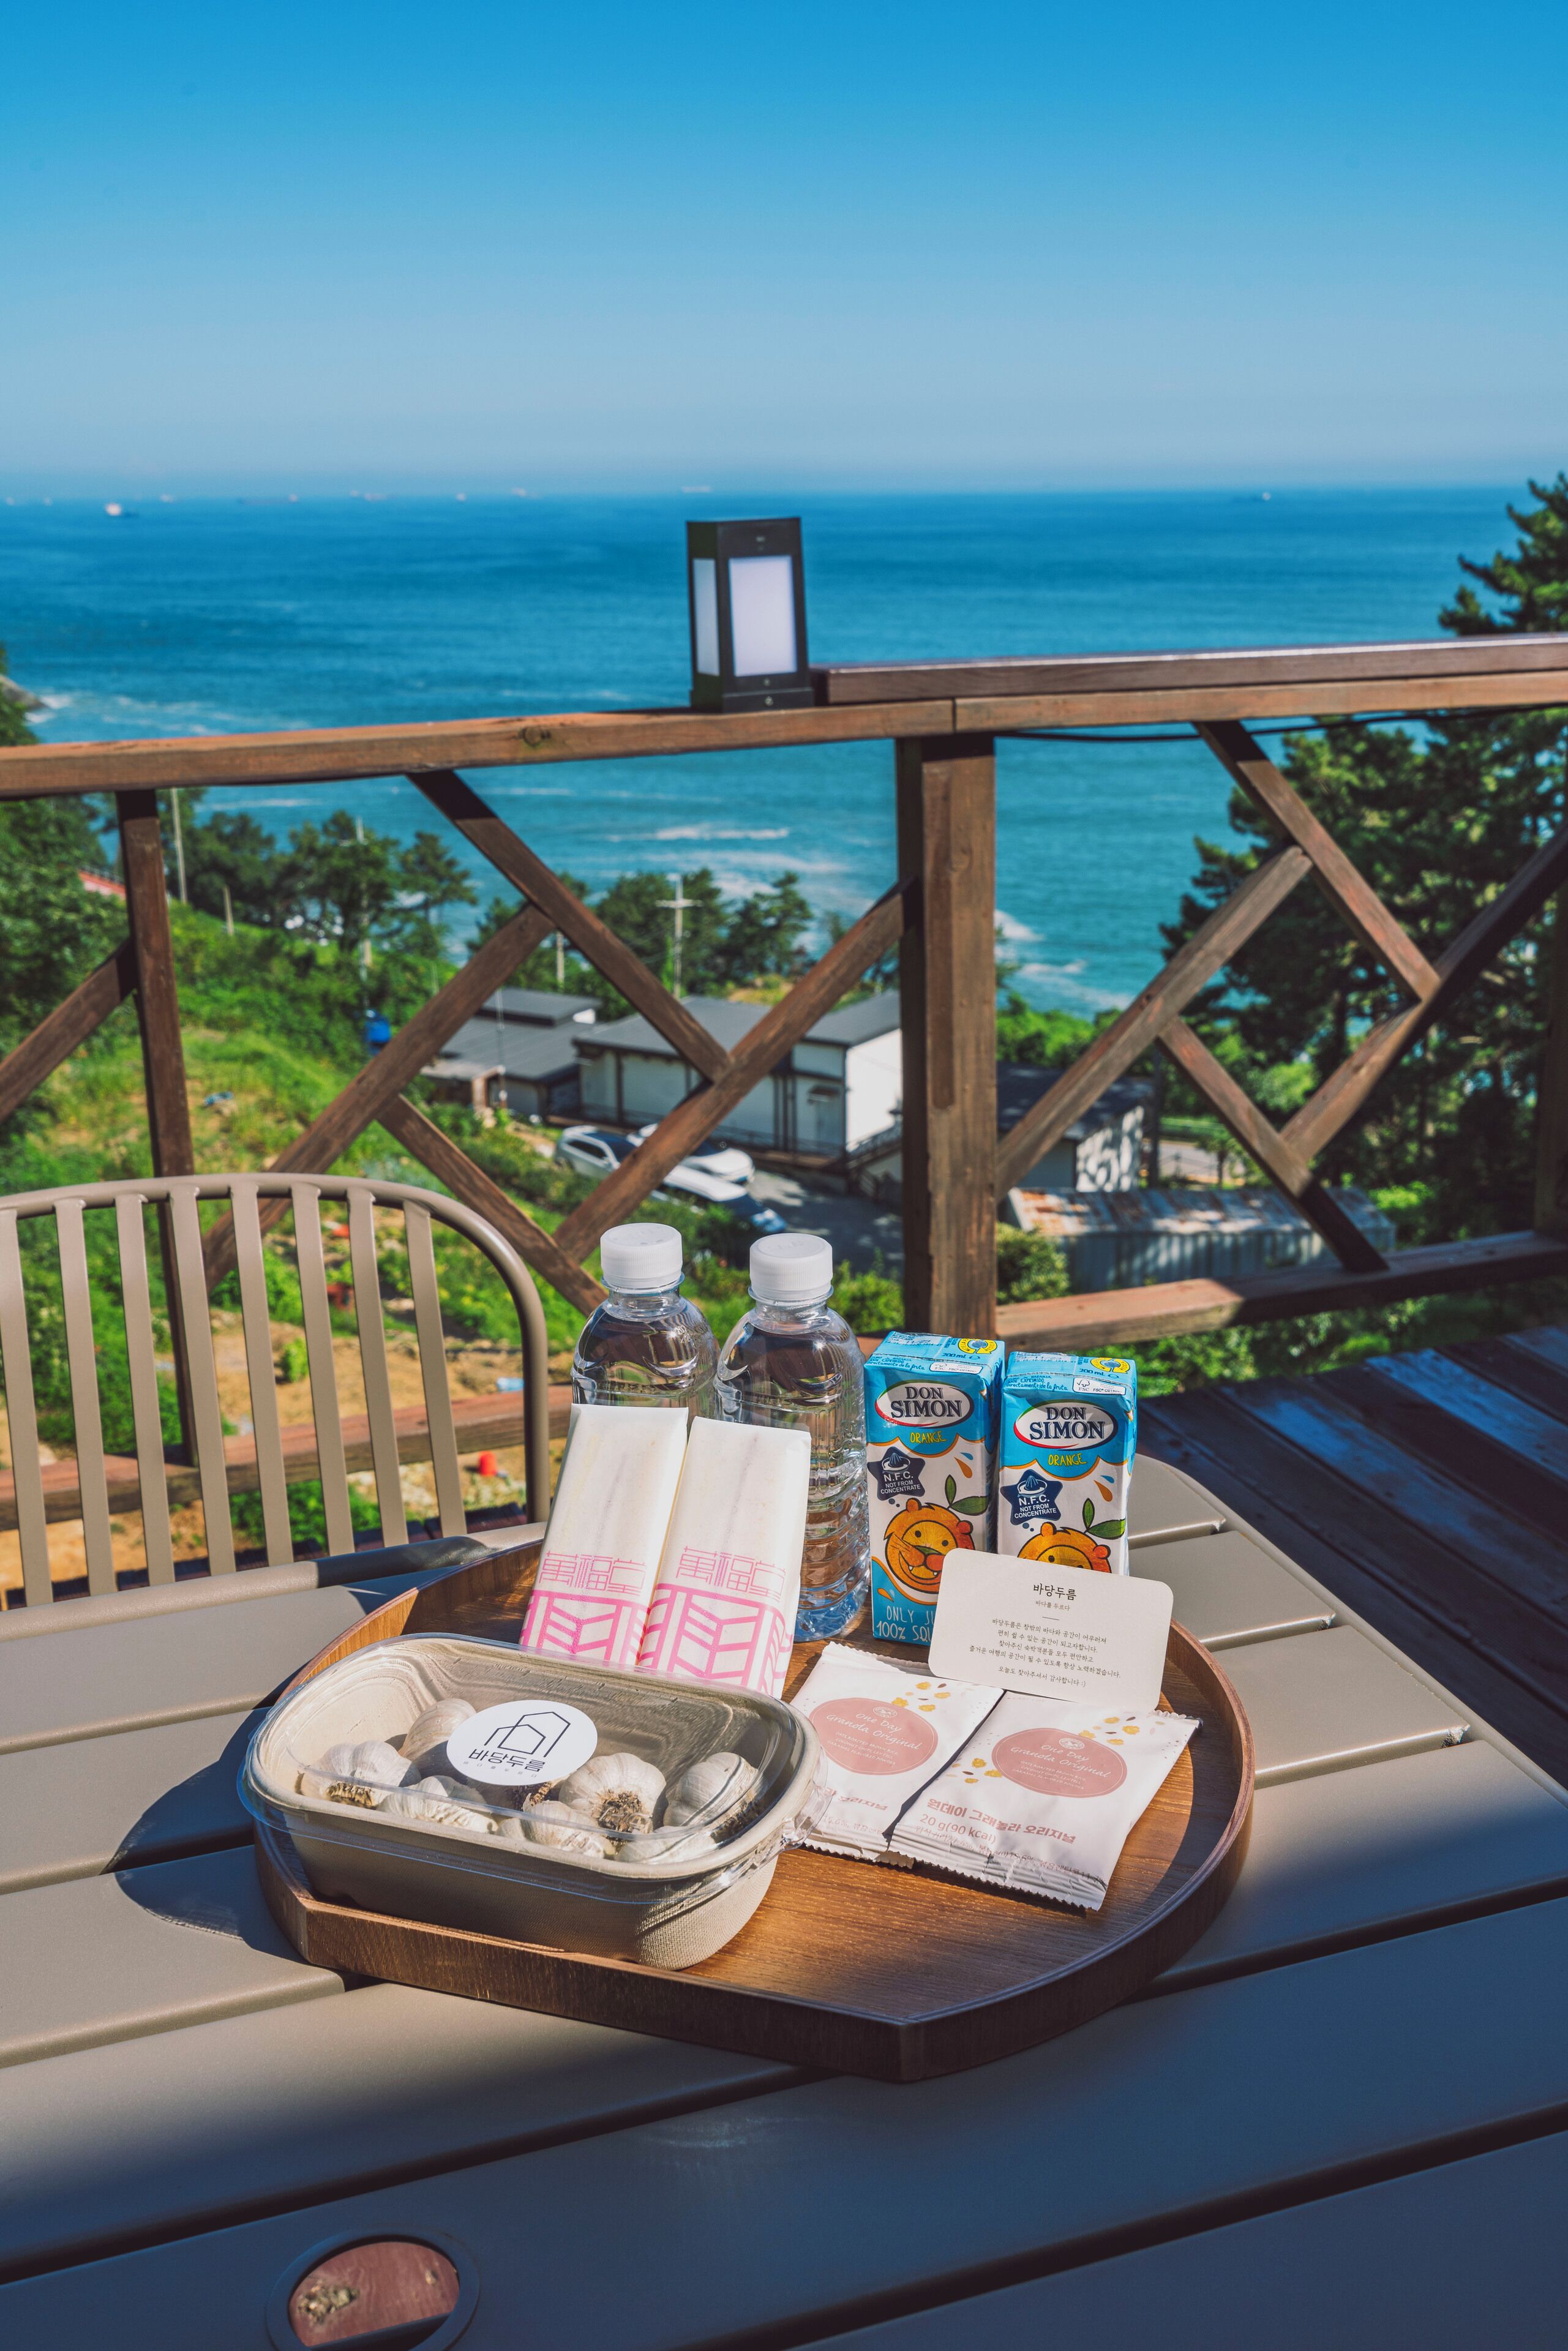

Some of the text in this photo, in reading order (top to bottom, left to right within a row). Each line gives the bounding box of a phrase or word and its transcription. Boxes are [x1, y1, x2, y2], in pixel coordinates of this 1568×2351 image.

[905, 1387, 943, 1400] DON
[891, 1400, 962, 1418] SIMON
[1045, 1407, 1087, 1420] DON
[910, 1431, 947, 1444] ORANGE
[1029, 1421, 1106, 1440] SIMON
[1048, 1453, 1087, 1466] ORANGE
[883, 1471, 913, 1482] N.F.C.
[880, 1484, 921, 1494] CONCENTRATE
[1018, 1494, 1050, 1505] N.F.C.
[1015, 1507, 1057, 1518] CONCENTRATE
[1033, 1582, 1077, 1601] 바당두름
[887, 1605, 914, 1623] ONLY
[876, 1621, 906, 1639] 100%
[992, 1618, 1106, 1644] 바당두름은 창밖의 바다와 공간이 어우러져
[999, 1640, 1022, 1651] 찾아주신
[1024, 1645, 1054, 1655] 숙박객분들
[1070, 1653, 1093, 1662] 편안하고
[1040, 1637, 1058, 1646] 공간이
[1060, 1641, 1097, 1653] 되고자합니다.
[970, 1646, 986, 1654] 즐거운
[989, 1649, 1006, 1657] 여행의
[1008, 1652, 1026, 1661] 공간이
[1044, 1659, 1061, 1667] 있도록
[1018, 1669, 1047, 1680] 찾아주셔서
[1050, 1675, 1079, 1686] 감사합니다
[827, 1714, 923, 1750] Granola Original
[856, 1714, 902, 1734] One Day
[468, 1749, 546, 1772] 바당두름
[1010, 1747, 1111, 1778] Granola Original
[1041, 1745, 1090, 1762] One Day
[920, 1813, 937, 1826] 20
[938, 1821, 967, 1835] g(90
[969, 1826, 997, 1843] kcal)
[927, 1798, 1076, 1845] 원데이 그래놀라 오리지널
